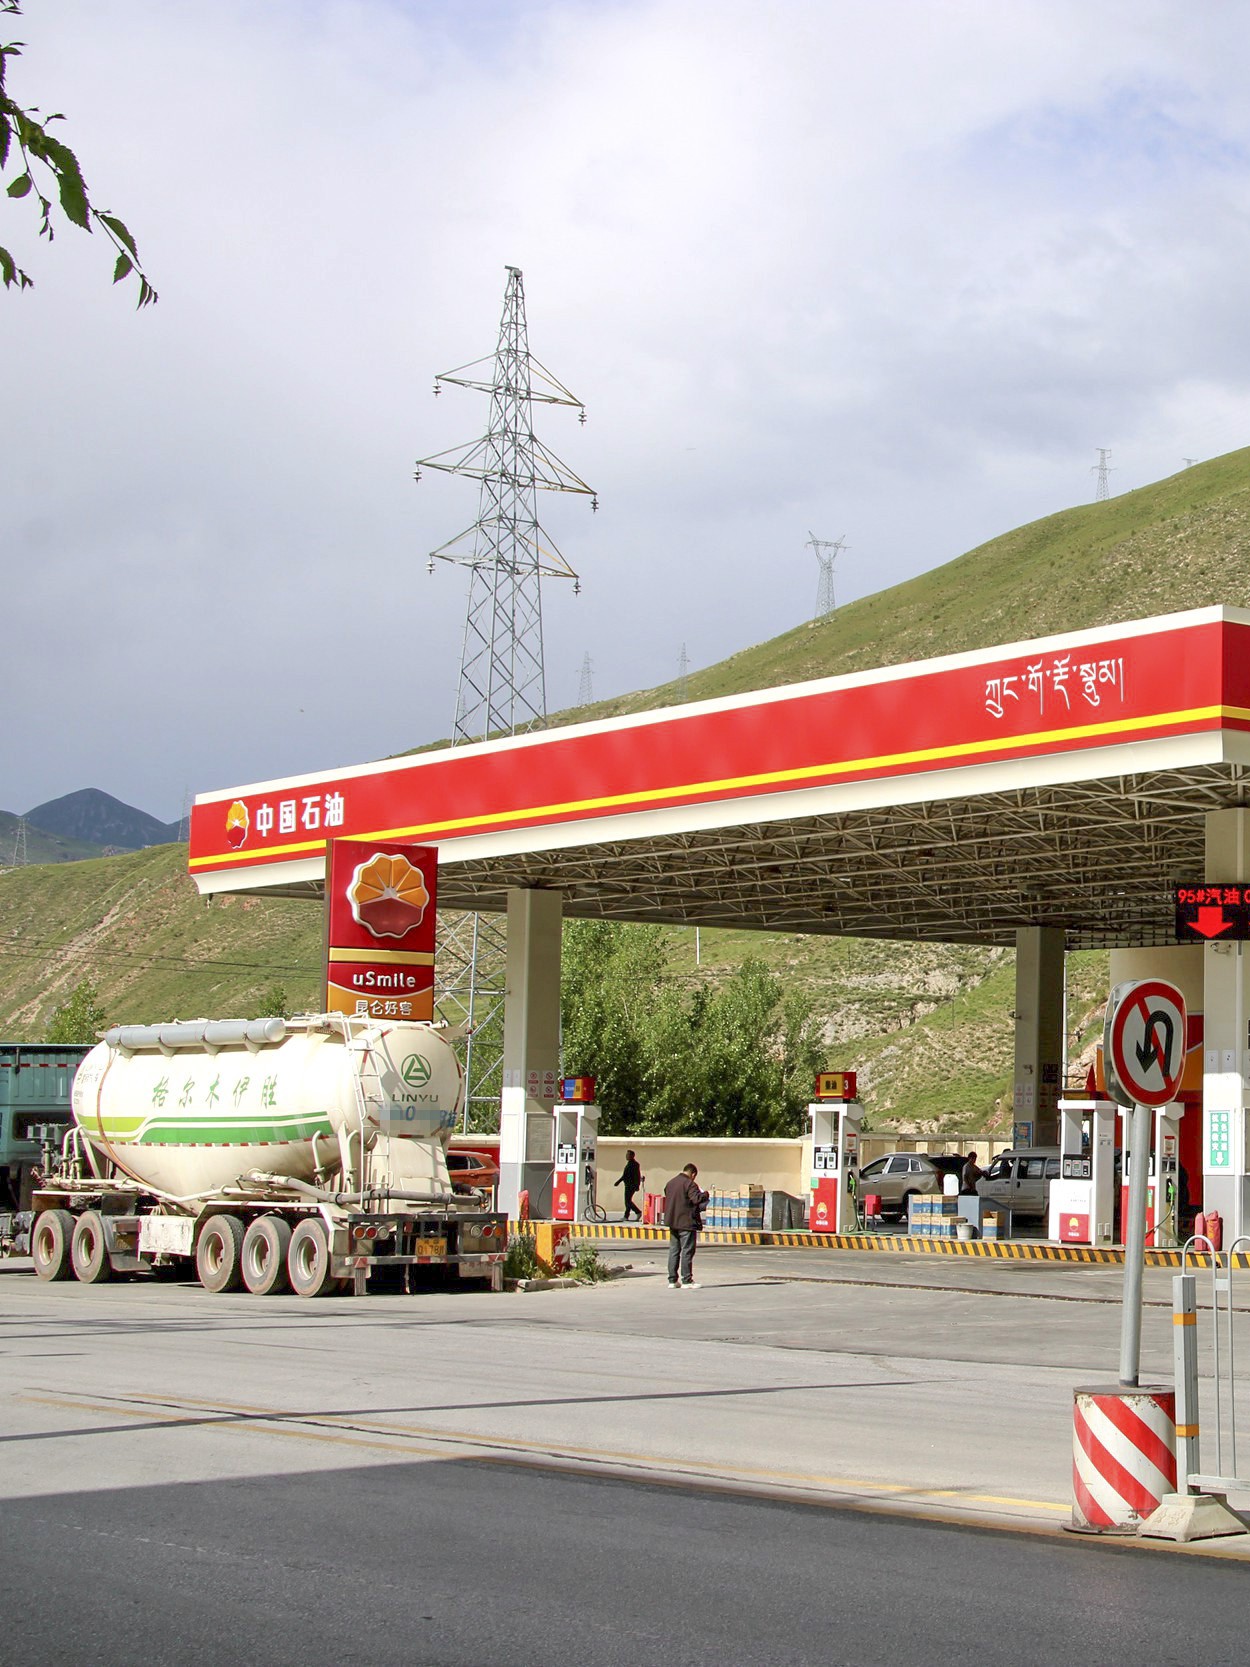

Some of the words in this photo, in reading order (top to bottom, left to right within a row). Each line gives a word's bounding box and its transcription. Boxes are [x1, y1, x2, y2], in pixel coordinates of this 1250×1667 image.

[256, 791, 345, 837] 中国石油
[1178, 888, 1240, 905] 95#汽油
[353, 971, 416, 988] uSmile
[355, 999, 413, 1016] 昆仑好客
[392, 1093, 439, 1103] LINYU
